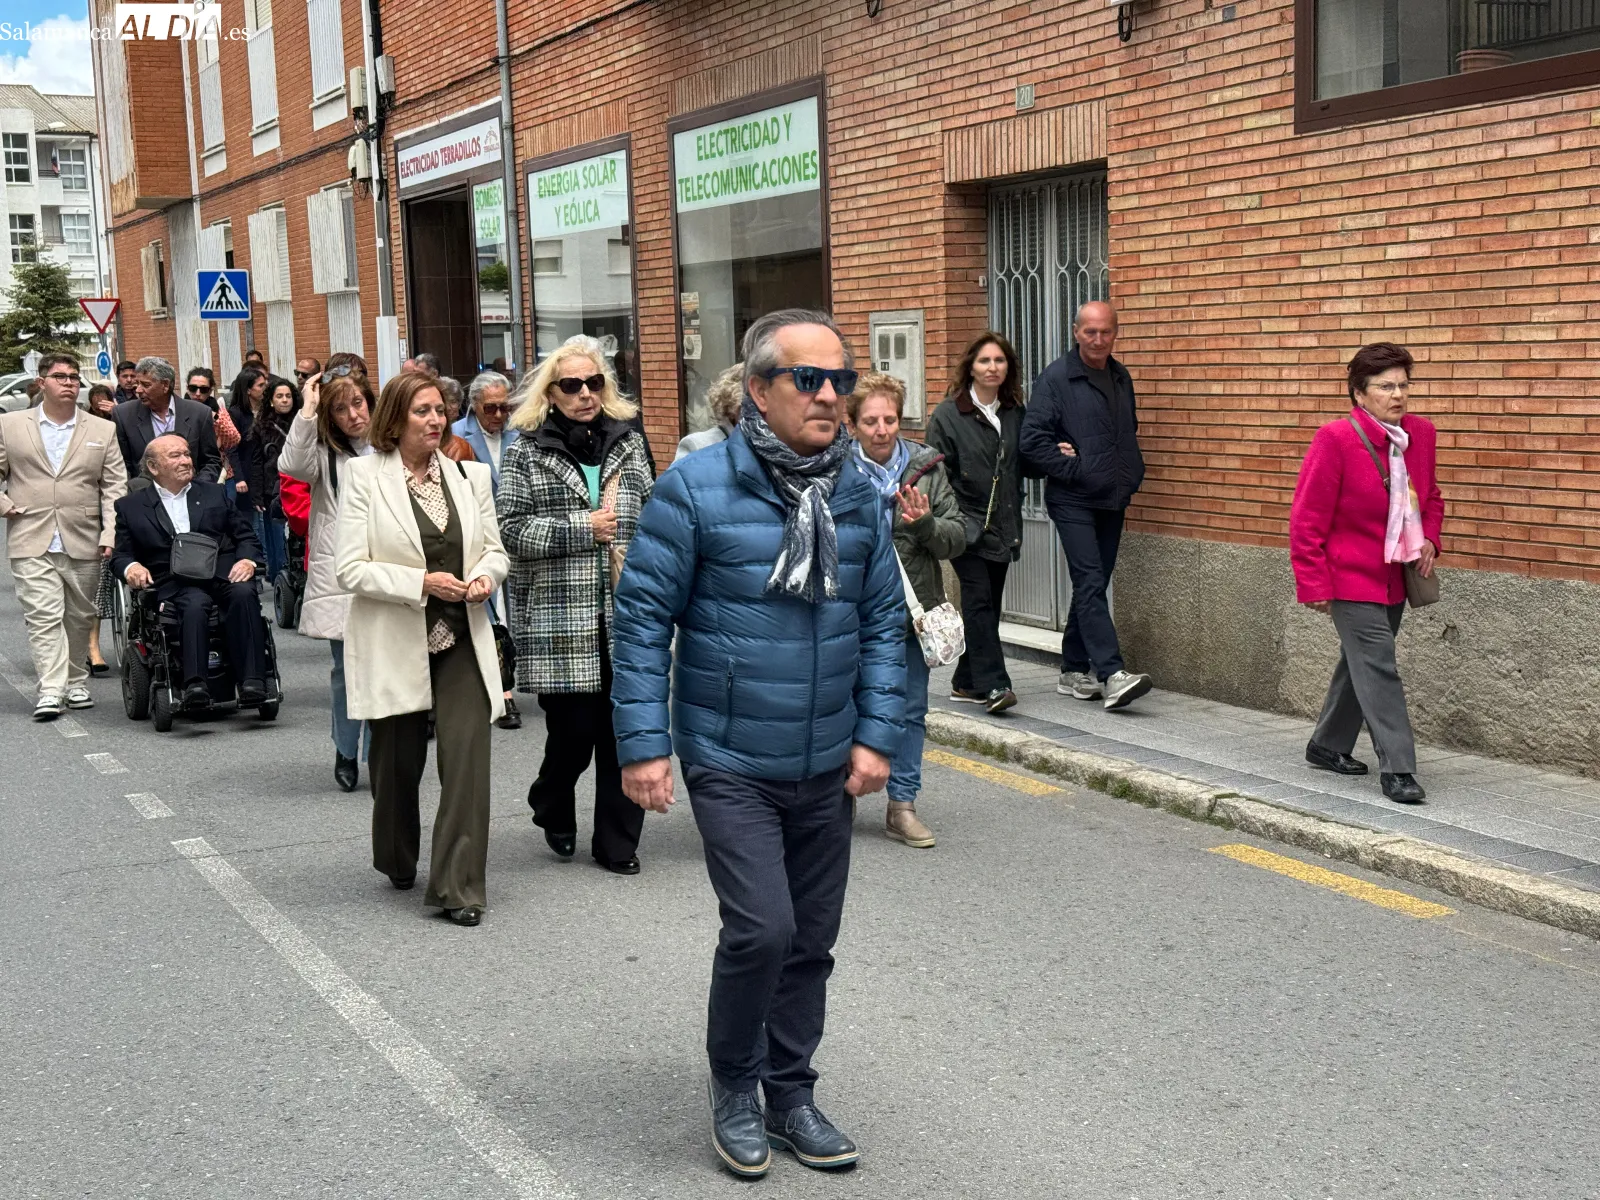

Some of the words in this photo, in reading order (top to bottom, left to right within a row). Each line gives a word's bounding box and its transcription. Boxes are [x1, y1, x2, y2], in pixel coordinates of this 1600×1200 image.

[1020, 86, 1030, 105] 20
[697, 116, 780, 162] ELECTRICIDAD
[783, 112, 793, 141] Y
[401, 152, 440, 179] ELECTRICIDAD
[440, 136, 481, 167] TERRADILLOS
[678, 150, 818, 203] TELECOMUNICACIONES
[537, 170, 580, 199] ENERGIA
[583, 159, 617, 189] SOLAR
[480, 216, 501, 239] SOLAR
[555, 206, 562, 229] Y
[564, 198, 601, 227] EÓLICA
